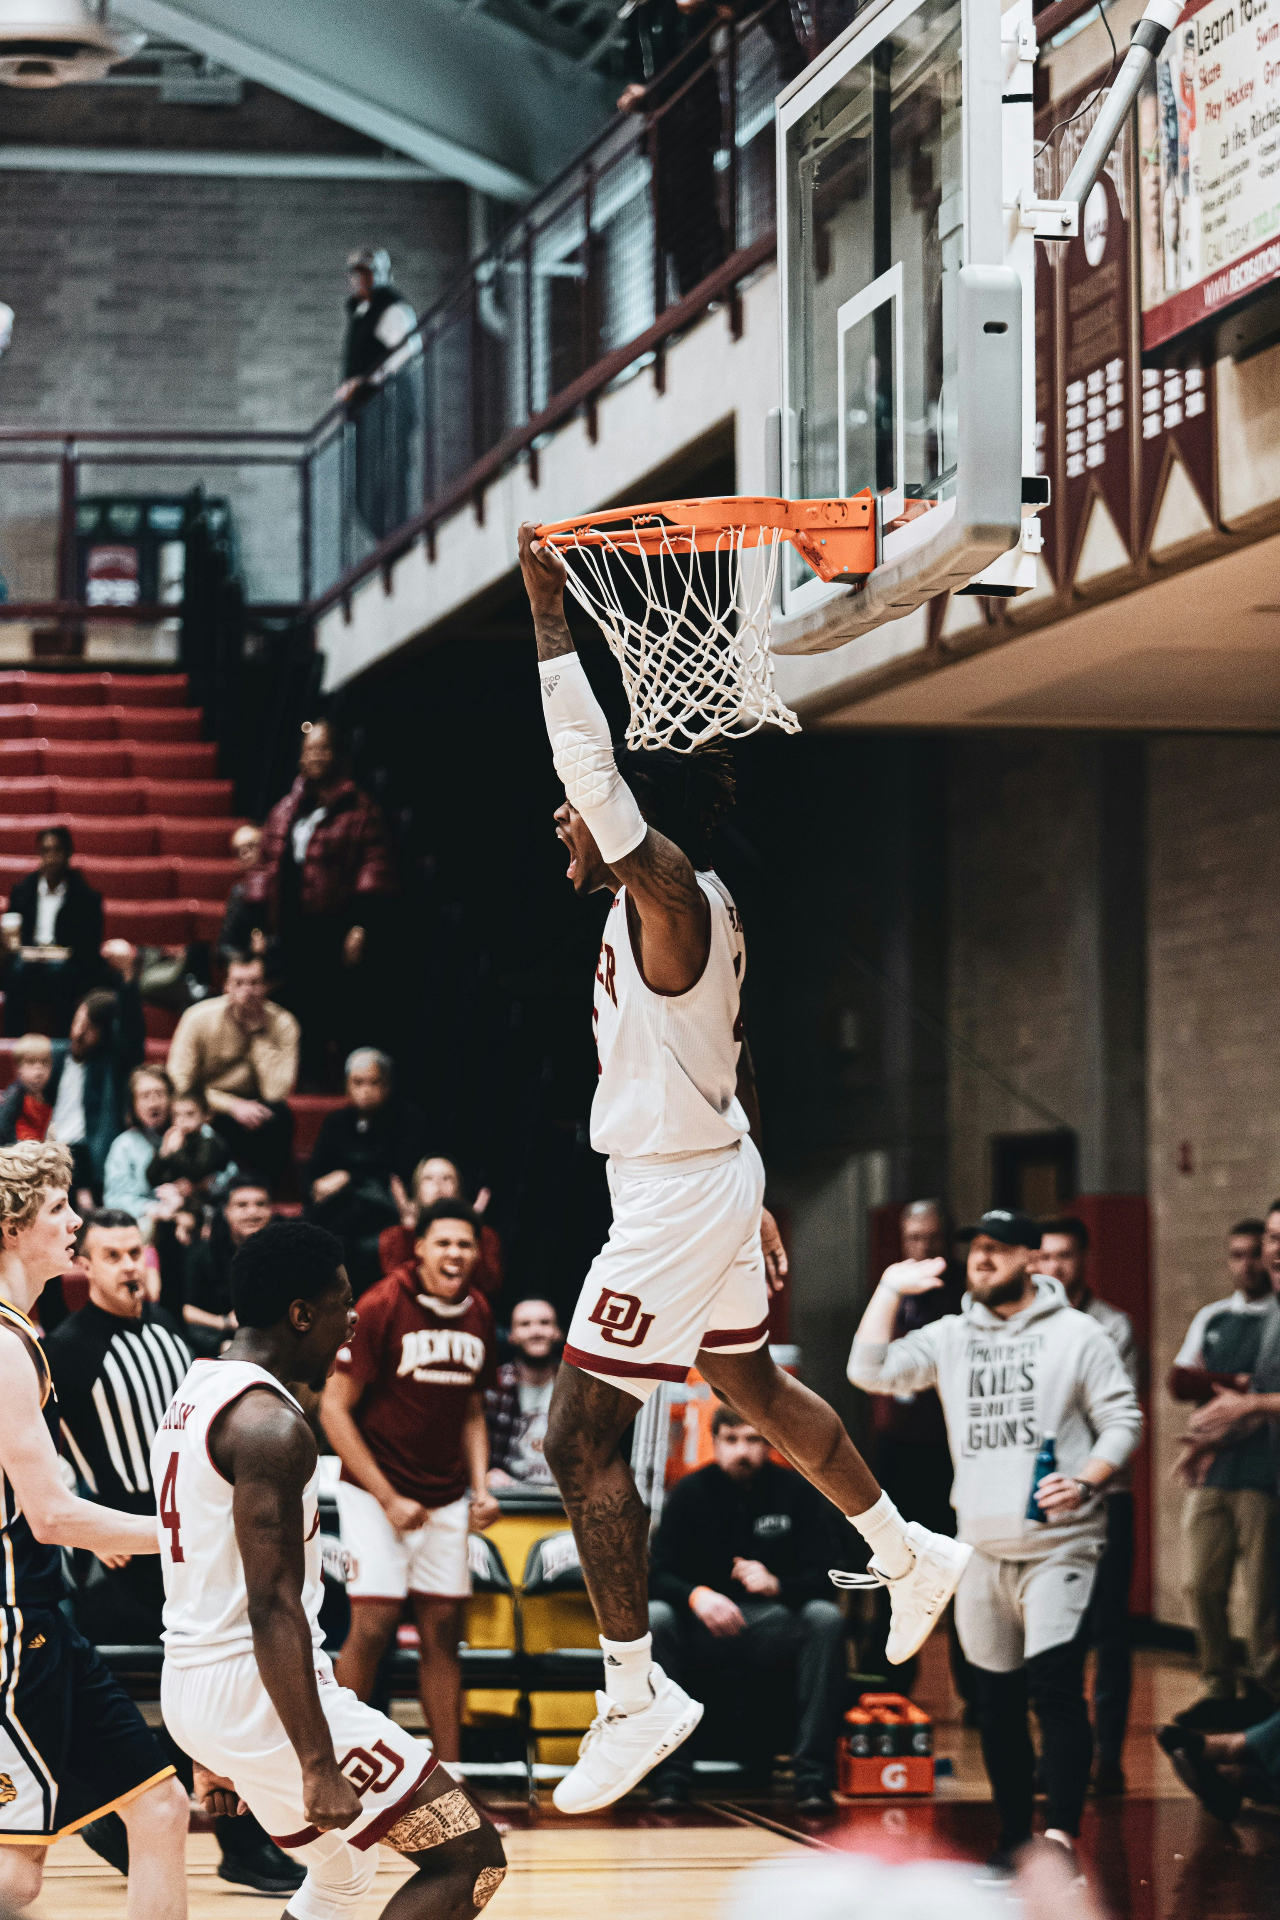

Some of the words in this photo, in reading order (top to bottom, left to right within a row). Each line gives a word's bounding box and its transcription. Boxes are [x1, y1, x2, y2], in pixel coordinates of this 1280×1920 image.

[1197, 7, 1234, 56] Learn
[1256, 18, 1279, 51] Swim
[1199, 63, 1221, 91] Skate
[1204, 98, 1222, 127] Play
[1224, 76, 1254, 113] Hockey
[1220, 134, 1229, 160] at
[1232, 121, 1247, 152] the
[969, 1416, 1035, 1450] GUNS
[160, 1452, 186, 1563] 4
[881, 1763, 908, 1791] G
